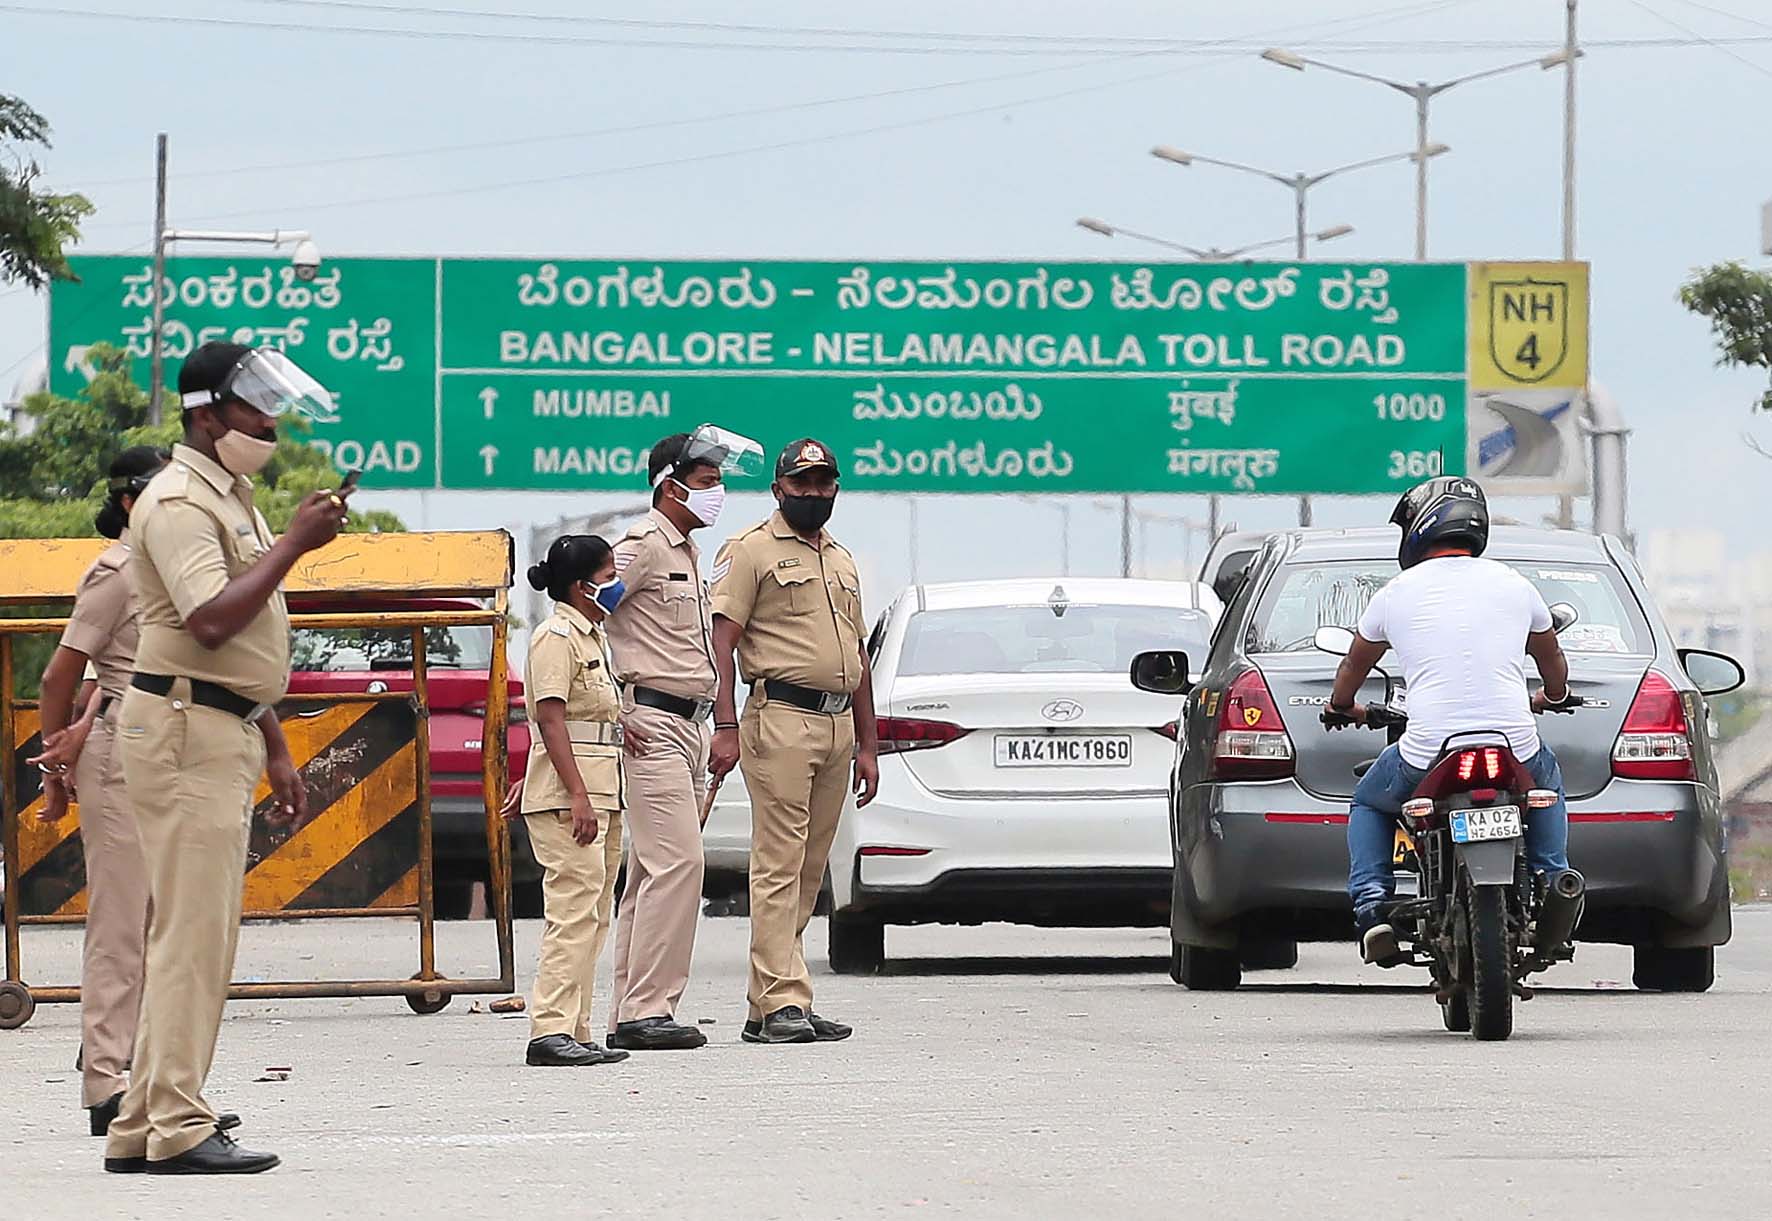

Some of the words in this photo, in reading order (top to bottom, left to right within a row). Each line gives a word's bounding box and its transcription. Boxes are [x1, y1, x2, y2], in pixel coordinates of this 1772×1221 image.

[518, 264, 776, 308] ಬೆಂಗಳೂರು
[838, 267, 1093, 309] ನೆಲಮಂಗಲ
[1111, 268, 1300, 310] ಟೋಲ್
[1320, 269, 1398, 323] ರಸ್ತೆ
[1504, 292, 1554, 321] NH
[328, 318, 404, 371] ರಸ್ತೆ
[501, 331, 774, 364] BANGALORE
[814, 333, 1146, 366] NELAMANGALA
[1157, 334, 1269, 366] TOLL
[1281, 334, 1405, 366] ROAD
[1516, 334, 1540, 370] 4
[533, 390, 670, 417] MUMBAI
[852, 384, 1042, 420] ಮುಂಬಯಿ
[1168, 379, 1240, 430] मुंबई
[1373, 394, 1446, 420] 1000
[853, 440, 1074, 476] ಮಂಗಳೂರು
[1388, 451, 1440, 478] 360
[1008, 739, 1129, 760] KA41MC1860
[1468, 811, 1487, 826] KA
[1492, 810, 1512, 823] 02
[1490, 824, 1520, 837] 4654
